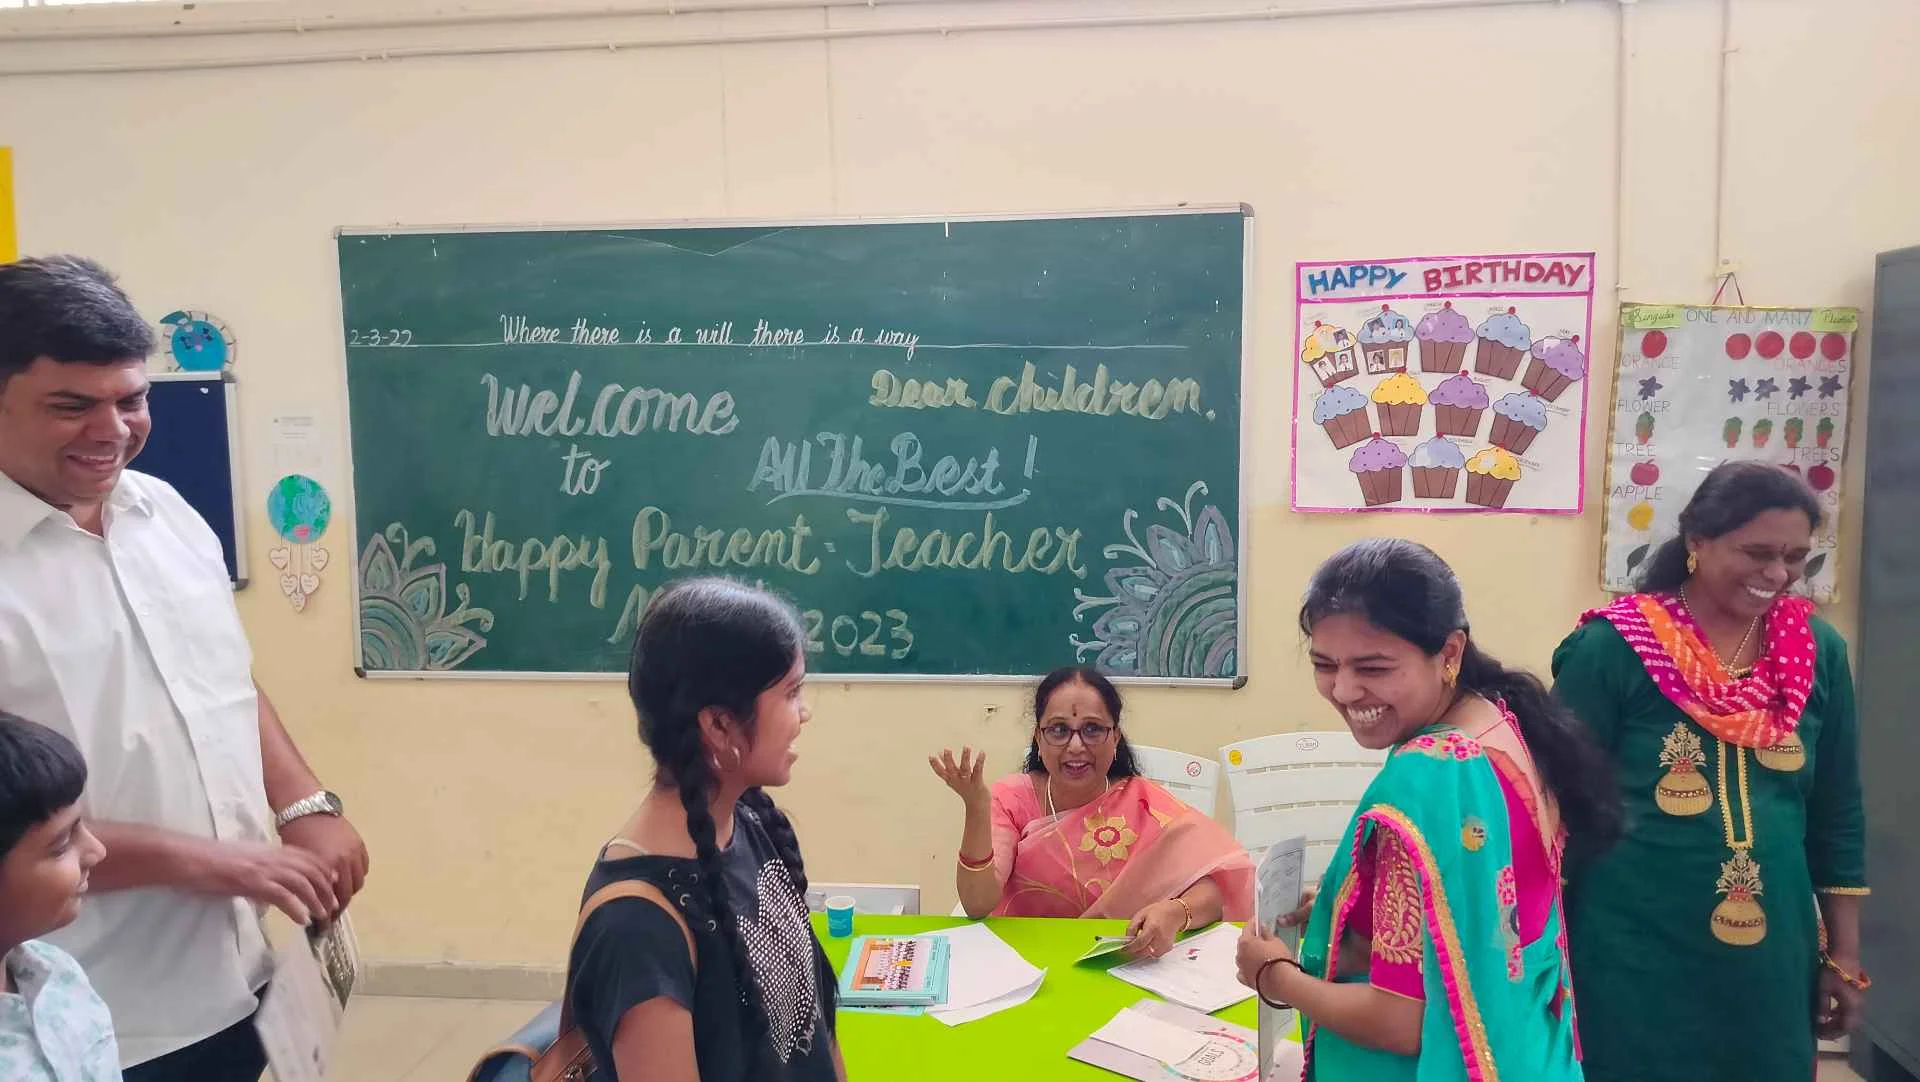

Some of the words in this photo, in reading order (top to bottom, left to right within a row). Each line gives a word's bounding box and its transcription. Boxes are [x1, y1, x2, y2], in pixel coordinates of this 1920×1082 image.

[1307, 265, 1408, 295] HAPPY
[1423, 260, 1586, 292] BIRTHDAY
[501, 314, 560, 343] Where
[570, 317, 619, 345] there
[635, 321, 652, 344] is
[664, 327, 682, 344] a
[696, 321, 734, 345] will
[750, 318, 805, 346] there
[821, 323, 841, 344] is
[848, 326, 865, 344] a
[873, 326, 920, 360] way
[1727, 310, 1755, 325] AND
[480, 369, 740, 437] Welcome
[869, 369, 977, 409] Dear
[1617, 400, 1672, 415] FLOWER
[560, 444, 611, 496] to
[746, 436, 812, 492] All
[886, 432, 1006, 496] Best
[1615, 443, 1657, 457] TREE
[1612, 485, 1663, 501] APPLE
[454, 509, 611, 609] Happy
[802, 608, 914, 660] 2023
[1198, 1048, 1225, 1066] GOALS
